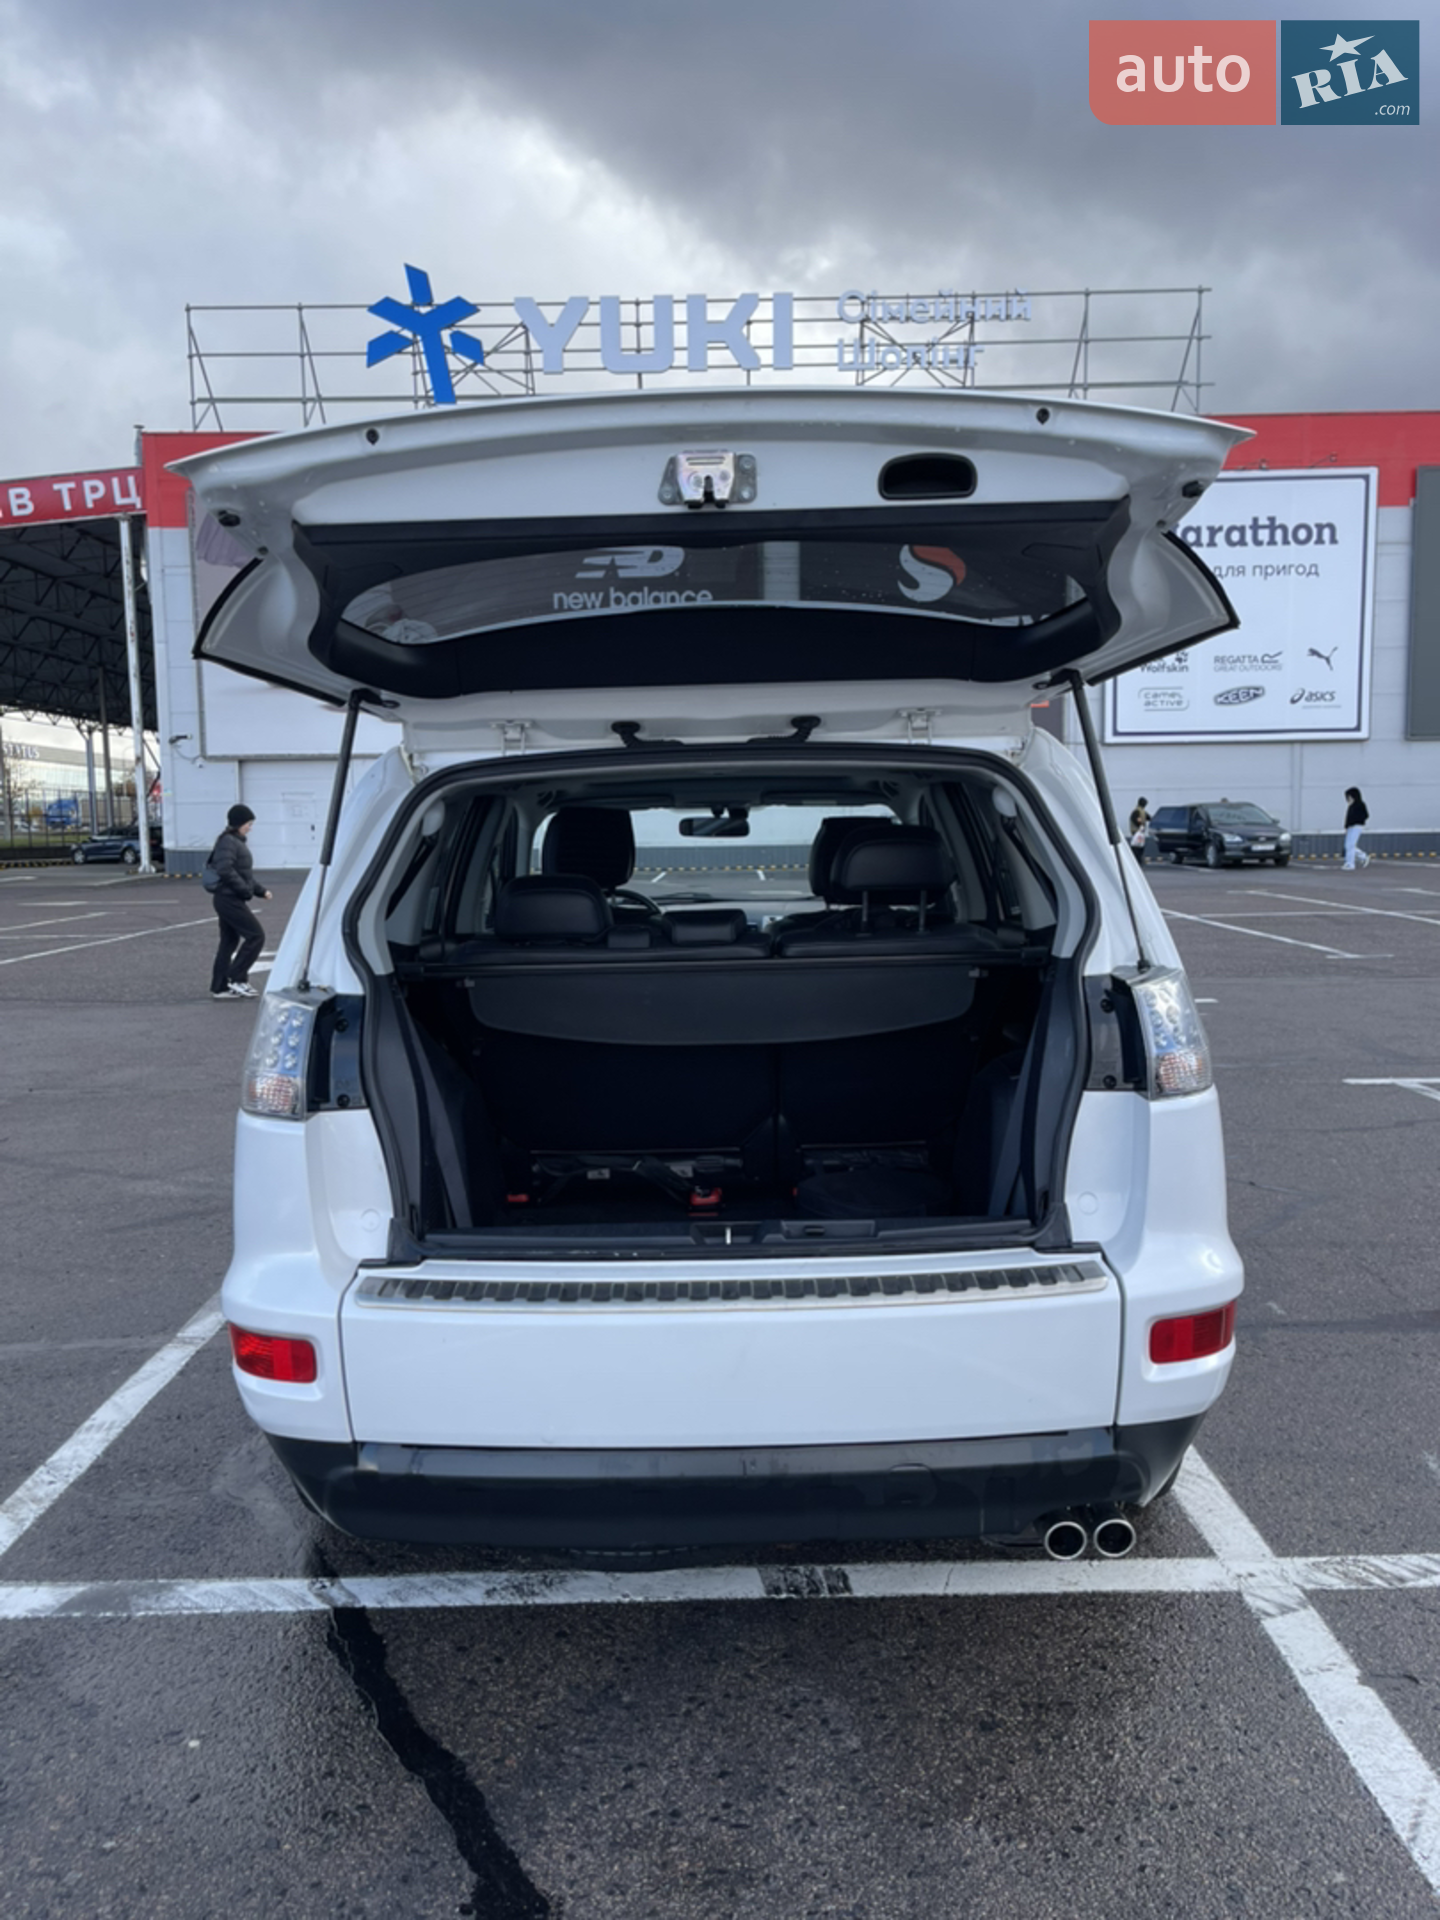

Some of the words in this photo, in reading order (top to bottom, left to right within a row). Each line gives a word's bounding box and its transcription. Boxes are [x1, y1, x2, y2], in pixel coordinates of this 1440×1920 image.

[837, 288, 1032, 324] Сімейний
[514, 292, 794, 375] YUKI
[837, 337, 985, 371] Шопінг
[0, 487, 35, 518] В
[52, 475, 142, 512] ТРЦ
[1173, 516, 1338, 548] arathon
[1213, 564, 1246, 579] для
[1252, 563, 1320, 580] пригод
[553, 592, 604, 610] new
[609, 587, 713, 608] balance
[1213, 655, 1260, 664] REGATTA
